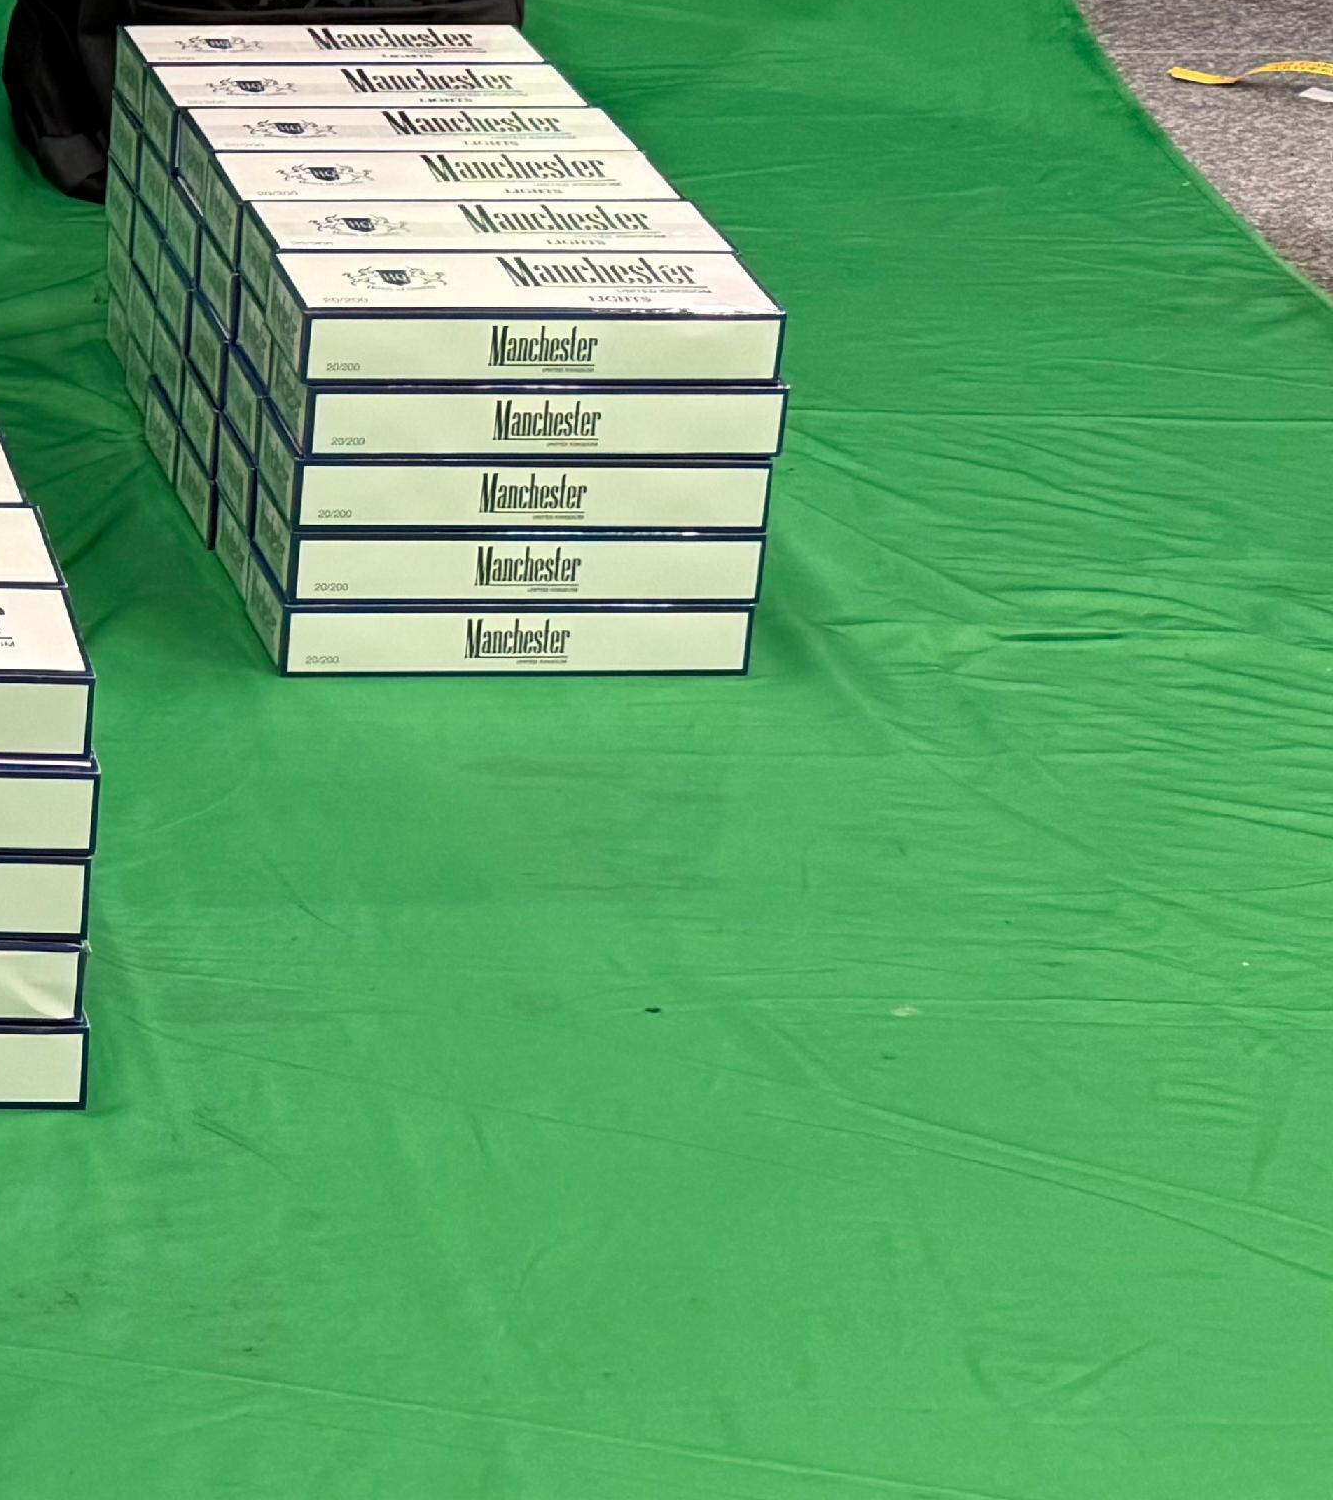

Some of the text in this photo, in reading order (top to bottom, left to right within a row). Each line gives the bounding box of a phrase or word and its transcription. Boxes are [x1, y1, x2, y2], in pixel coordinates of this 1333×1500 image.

[307, 27, 473, 50] Manchester
[340, 68, 514, 93] Manchester
[381, 110, 562, 135] Manchester
[420, 154, 605, 182] Manchester
[458, 204, 649, 234] Manchester
[496, 256, 697, 287] Manchester
[488, 325, 598, 367] Manchester
[492, 400, 602, 441] Manchester
[479, 473, 587, 513] Manchester
[318, 509, 352, 519] 20/200
[474, 546, 582, 586] Manchester
[464, 619, 571, 659] Manchester
